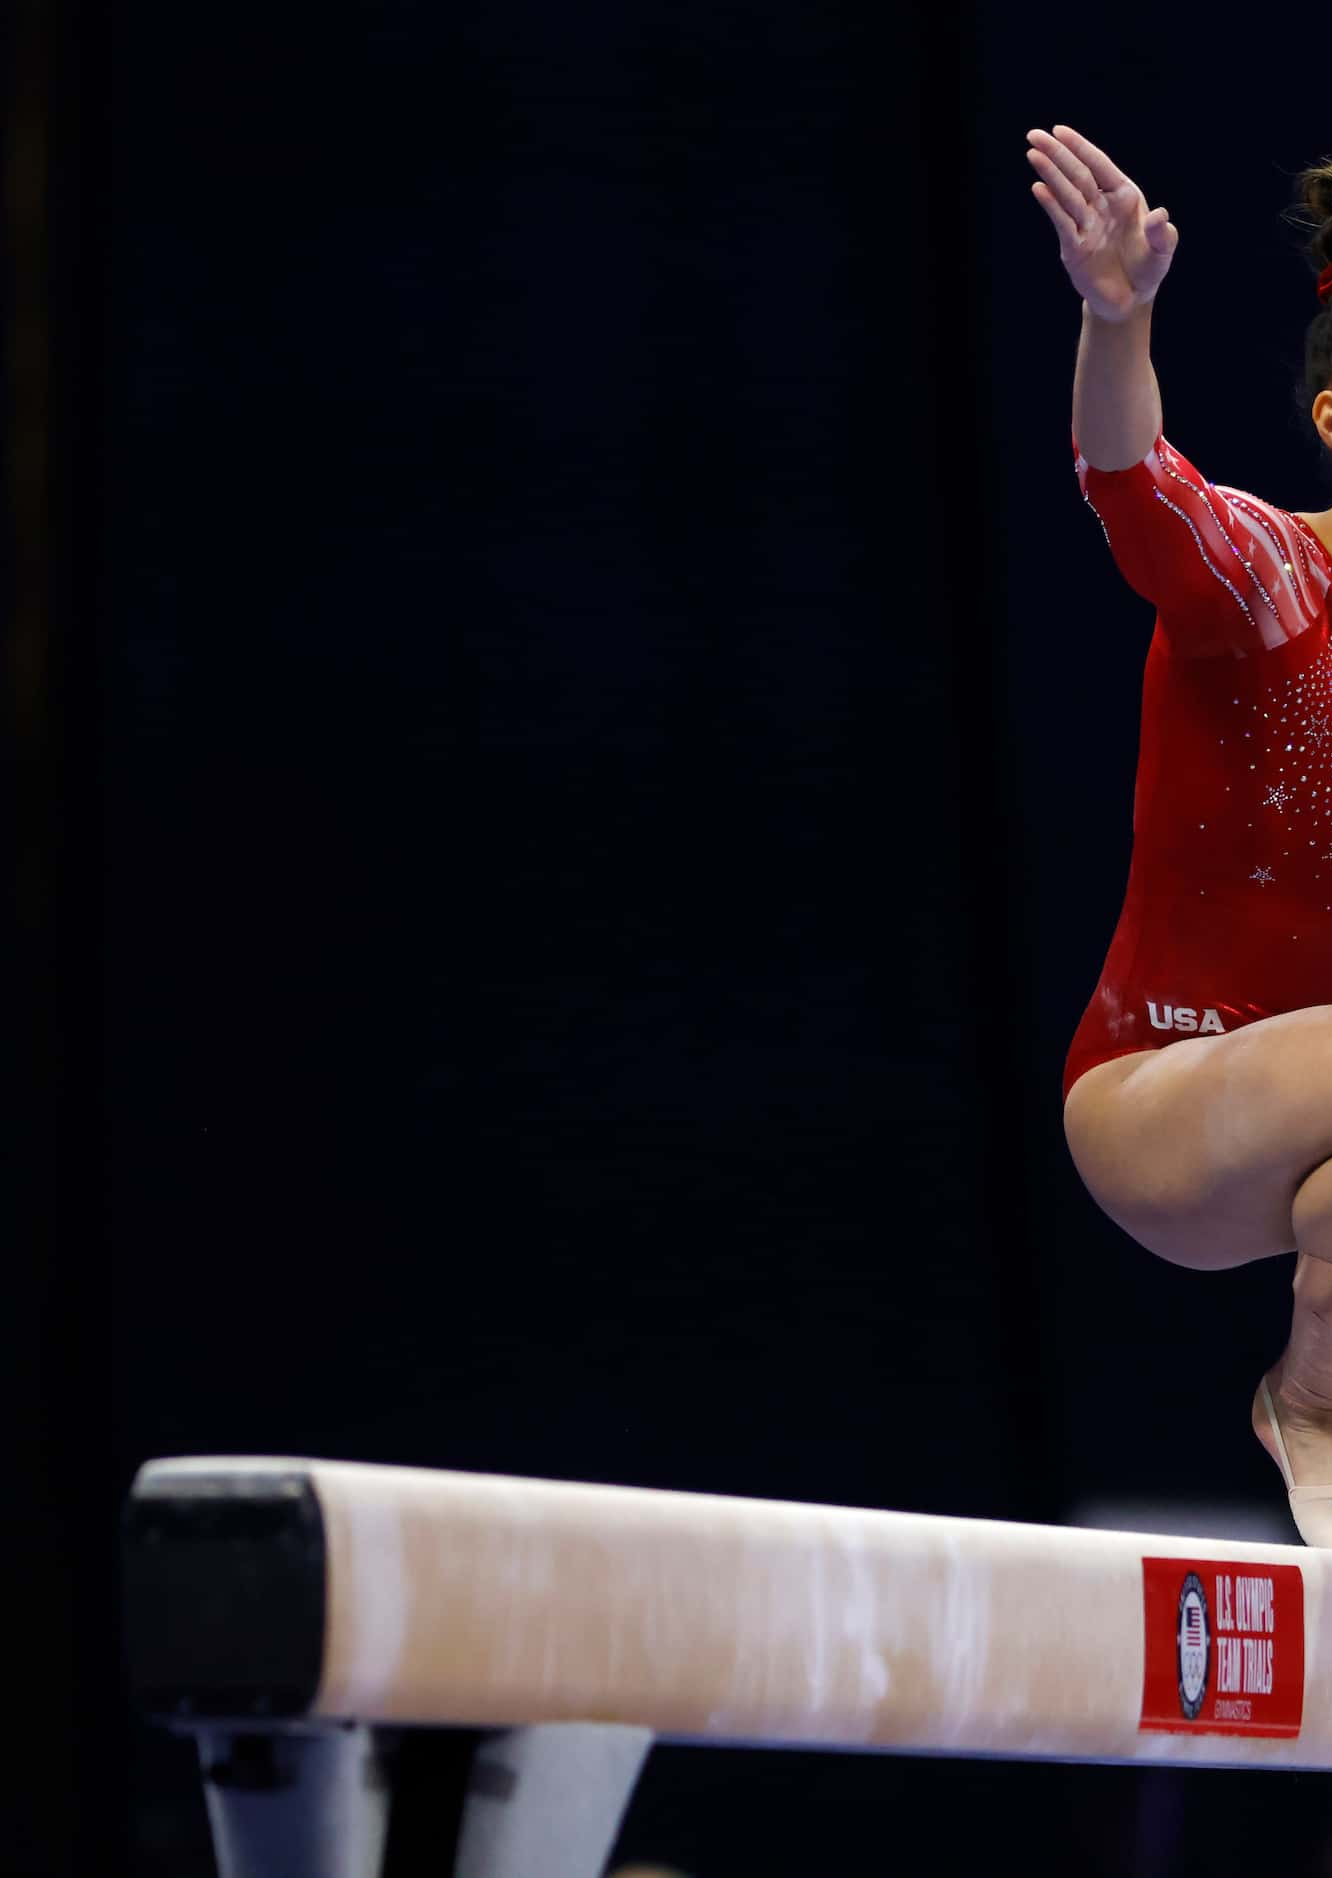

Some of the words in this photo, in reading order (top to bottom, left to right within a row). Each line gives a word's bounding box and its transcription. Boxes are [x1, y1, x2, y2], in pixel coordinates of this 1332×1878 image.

[1146, 1000, 1226, 1033] USA
[1216, 1575, 1235, 1631] U.S.
[1235, 1576, 1274, 1633] OLYMPIC
[1216, 1637, 1241, 1693] TEAM
[1243, 1639, 1273, 1694] TRIALS
